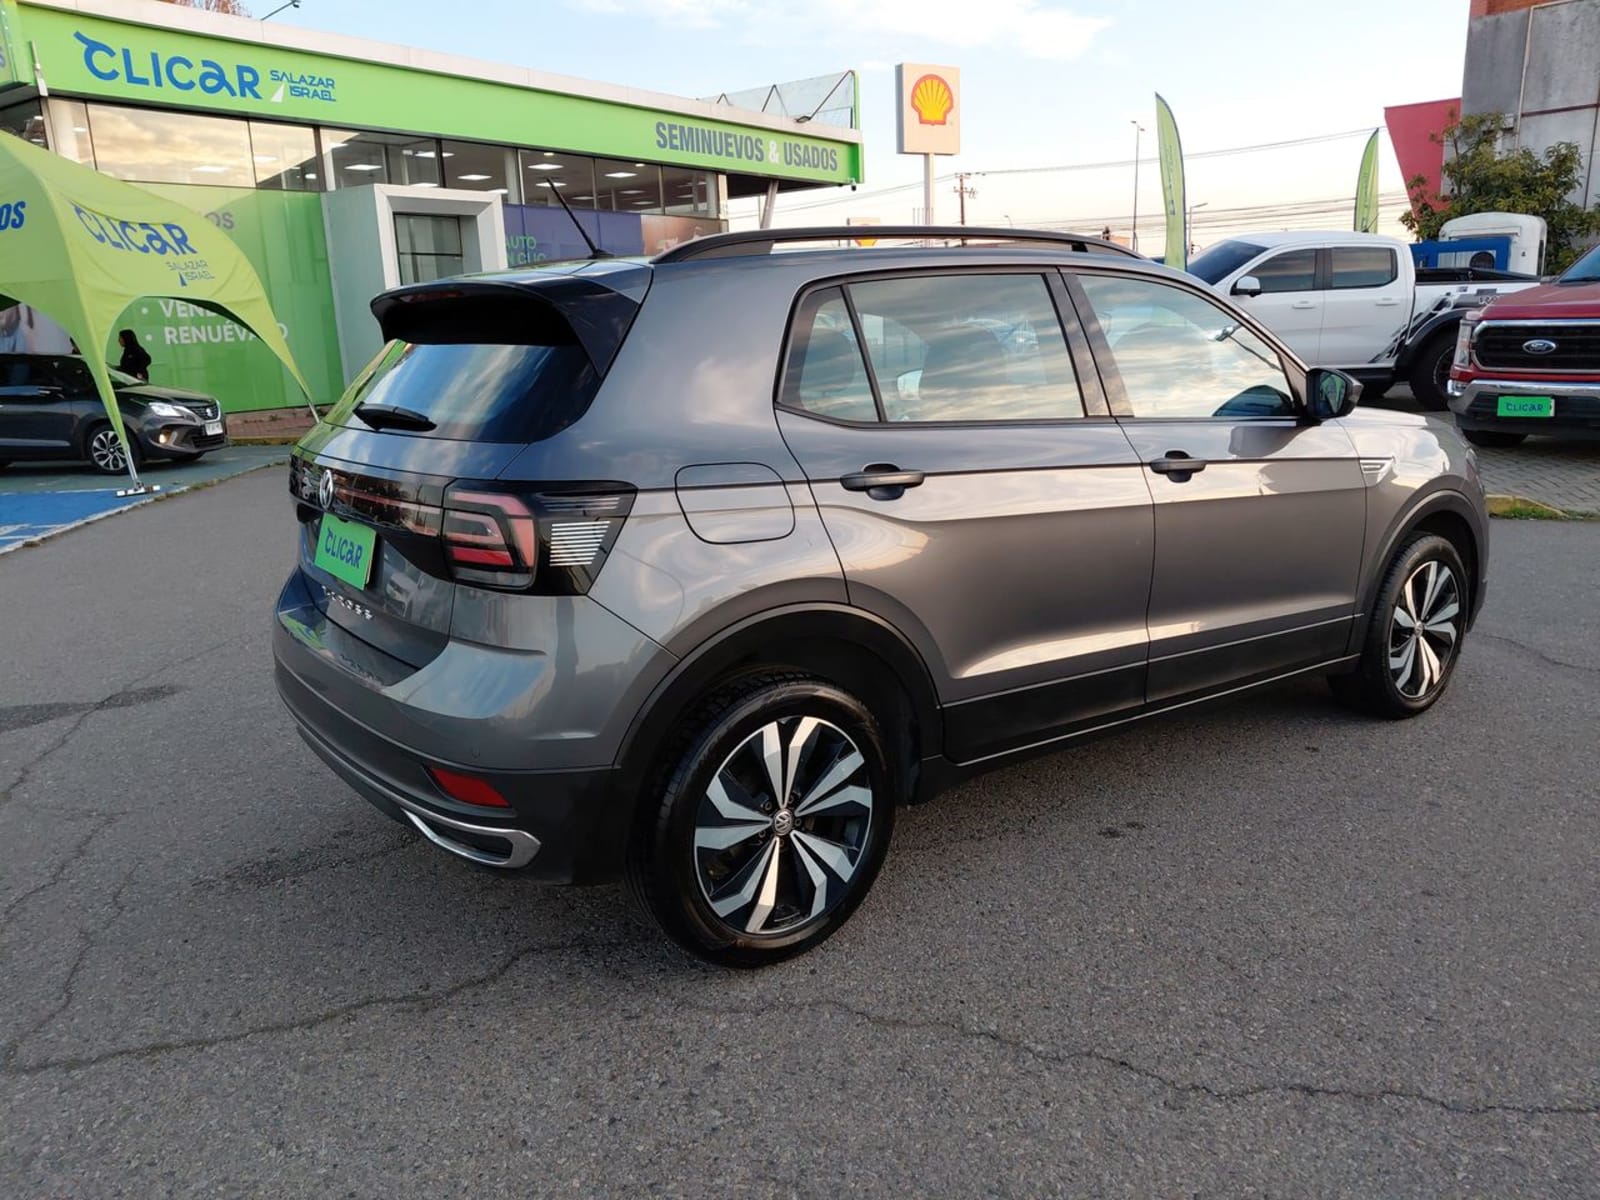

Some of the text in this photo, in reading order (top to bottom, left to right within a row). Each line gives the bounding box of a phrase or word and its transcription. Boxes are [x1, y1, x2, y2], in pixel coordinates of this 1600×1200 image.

[270, 70, 336, 89] SALAZAR
[290, 85, 337, 102] ISRAEL
[655, 121, 838, 172] SEMINUEVOS & USADOS
